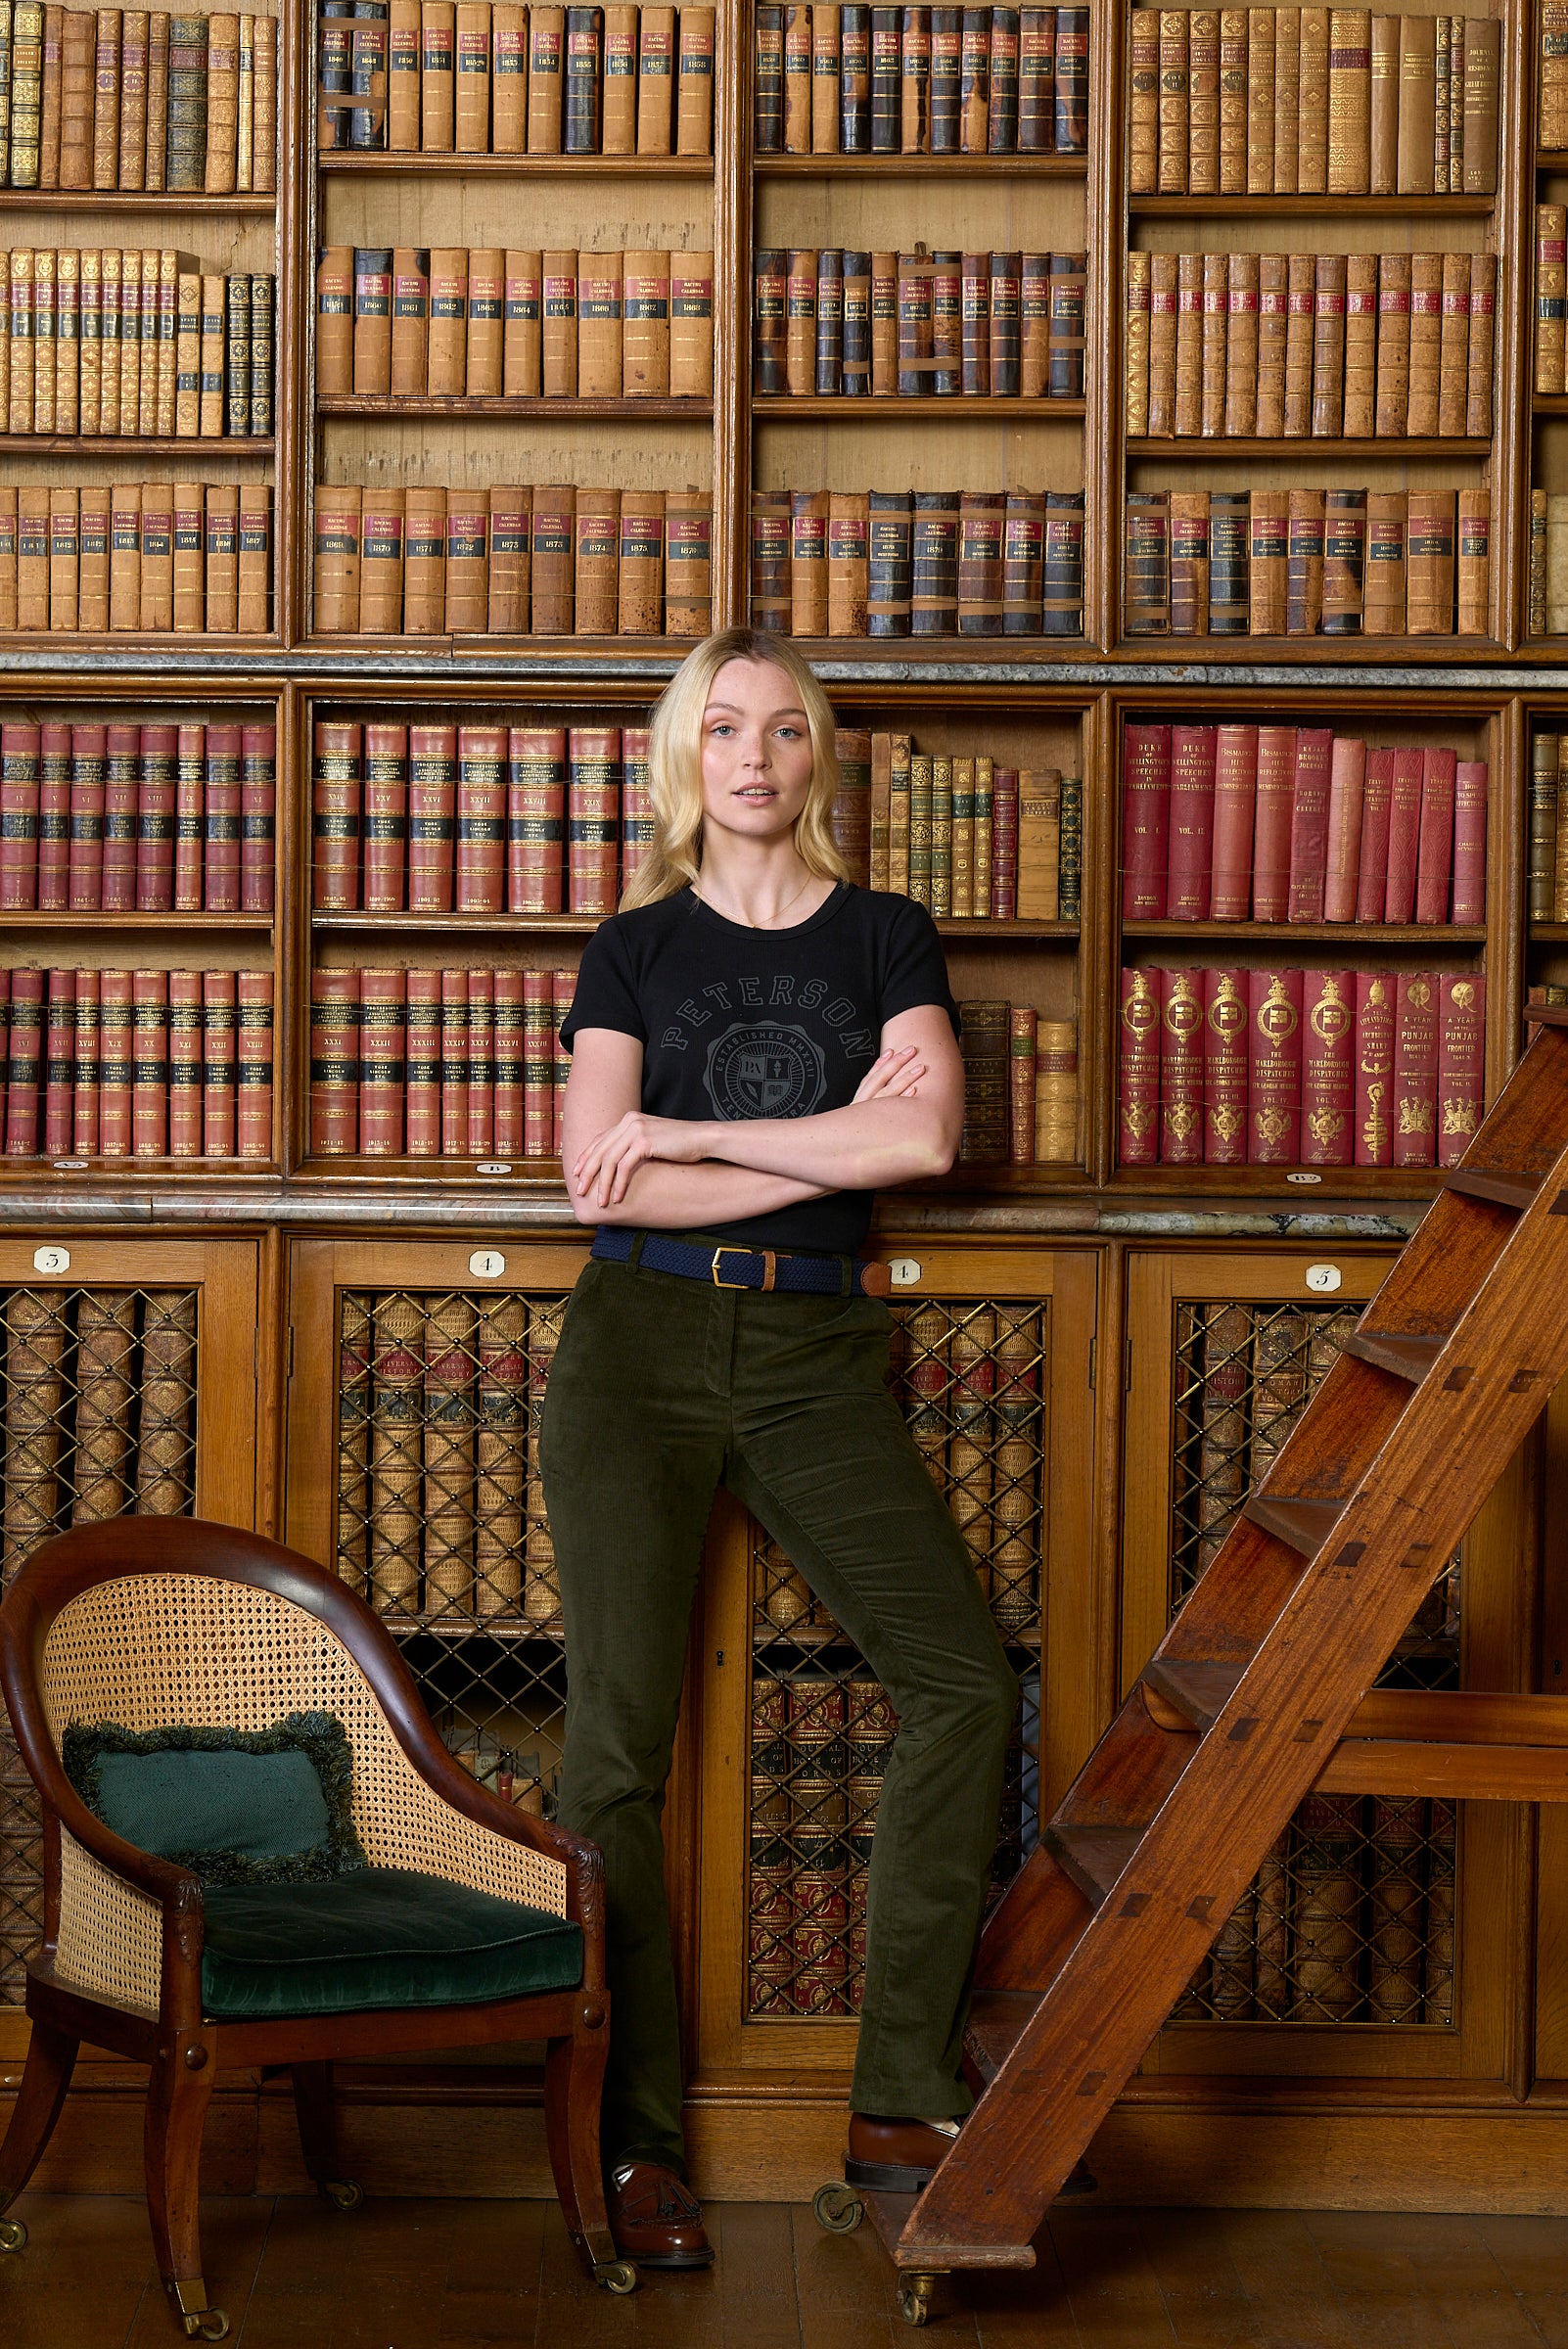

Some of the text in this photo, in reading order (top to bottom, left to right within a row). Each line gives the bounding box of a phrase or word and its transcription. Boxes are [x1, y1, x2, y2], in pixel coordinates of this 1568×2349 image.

[660, 976, 875, 1058] PETERSON
[1402, 1032, 1434, 1040] PUNJAB
[1446, 1032, 1478, 1040] PUNJAB
[715, 1032, 815, 1078] ESTABLISHED MMXXII
[1448, 1044, 1475, 1053] FRONTIER
[46, 1254, 59, 1267] 3
[480, 1257, 493, 1271] 4
[896, 1265, 909, 1279] 4
[1315, 1270, 1330, 1286] 5
